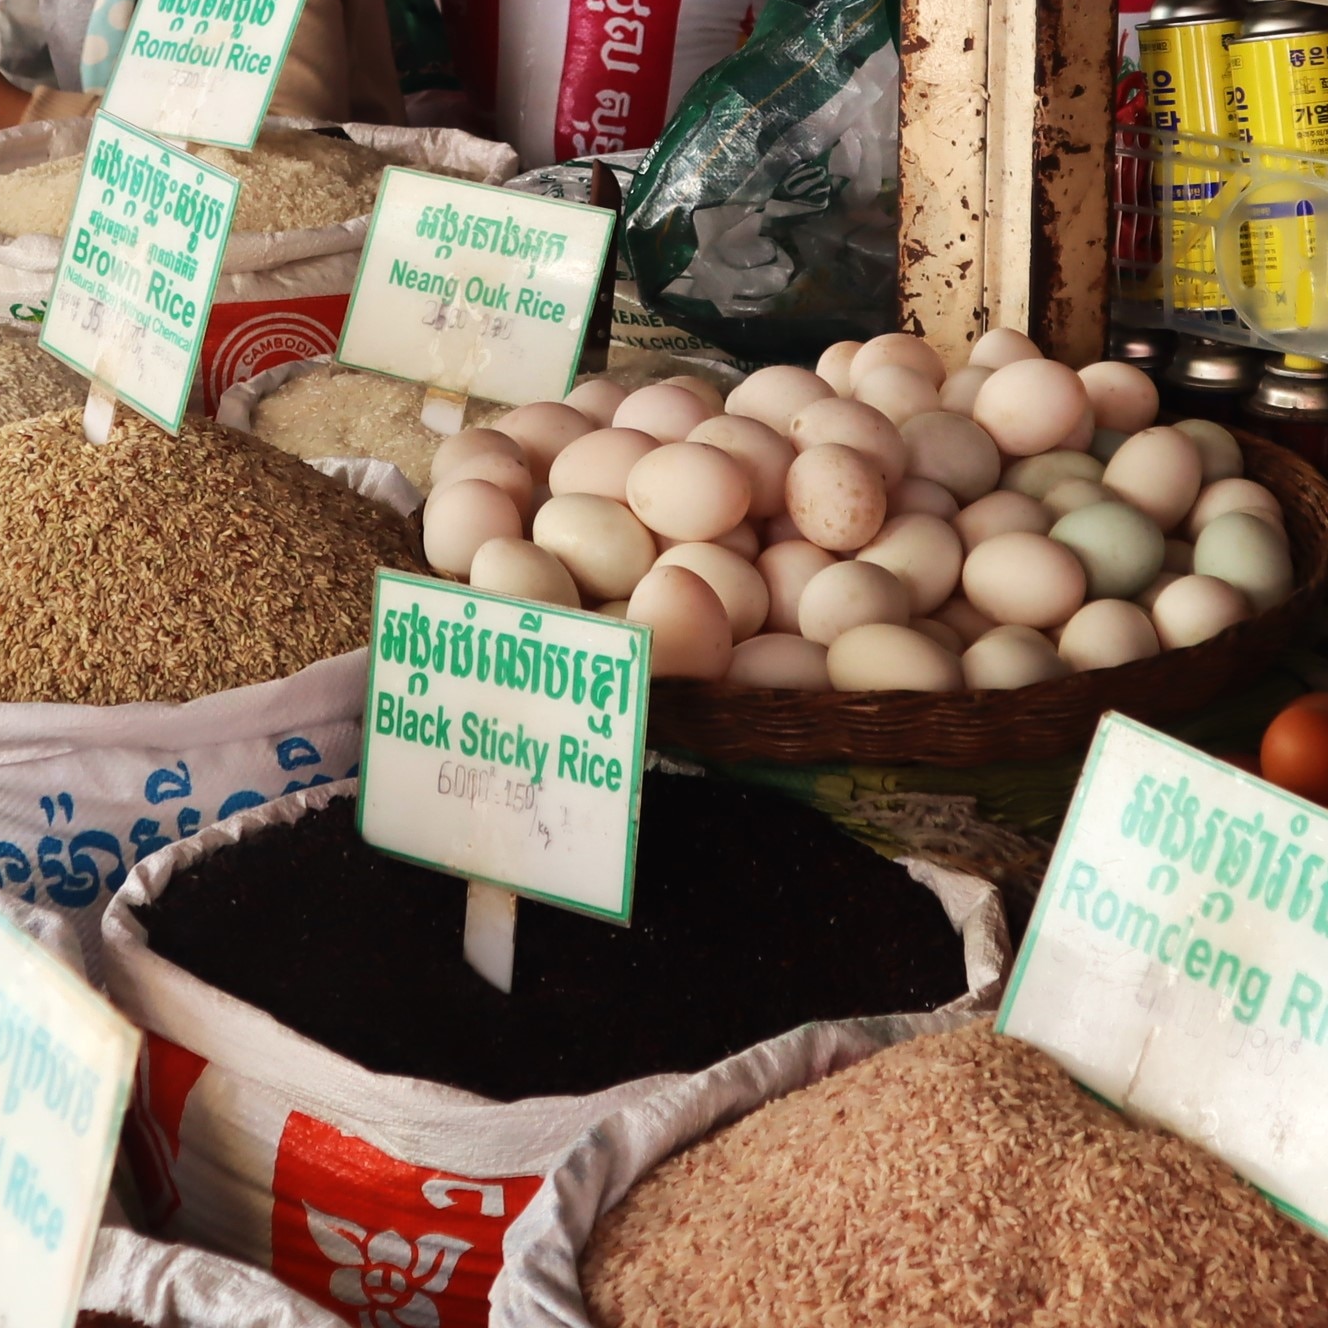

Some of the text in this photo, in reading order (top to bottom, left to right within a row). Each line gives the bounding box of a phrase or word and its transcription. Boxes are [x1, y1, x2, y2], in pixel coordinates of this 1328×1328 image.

[131, 29, 272, 76] Romdoul Rice
[63, 265, 96, 296] (Natural
[118, 296, 152, 329] Without
[151, 317, 193, 355] Chemical
[71, 227, 142, 297] Brown
[145, 268, 196, 329] Rice
[388, 259, 460, 306] Neang
[464, 275, 512, 311] Ouk
[513, 287, 567, 324] Rice
[375, 690, 624, 793] Black Sticky Rice
[1057, 858, 1274, 1028] Romdeng
[1, 1150, 66, 1253] Rice
